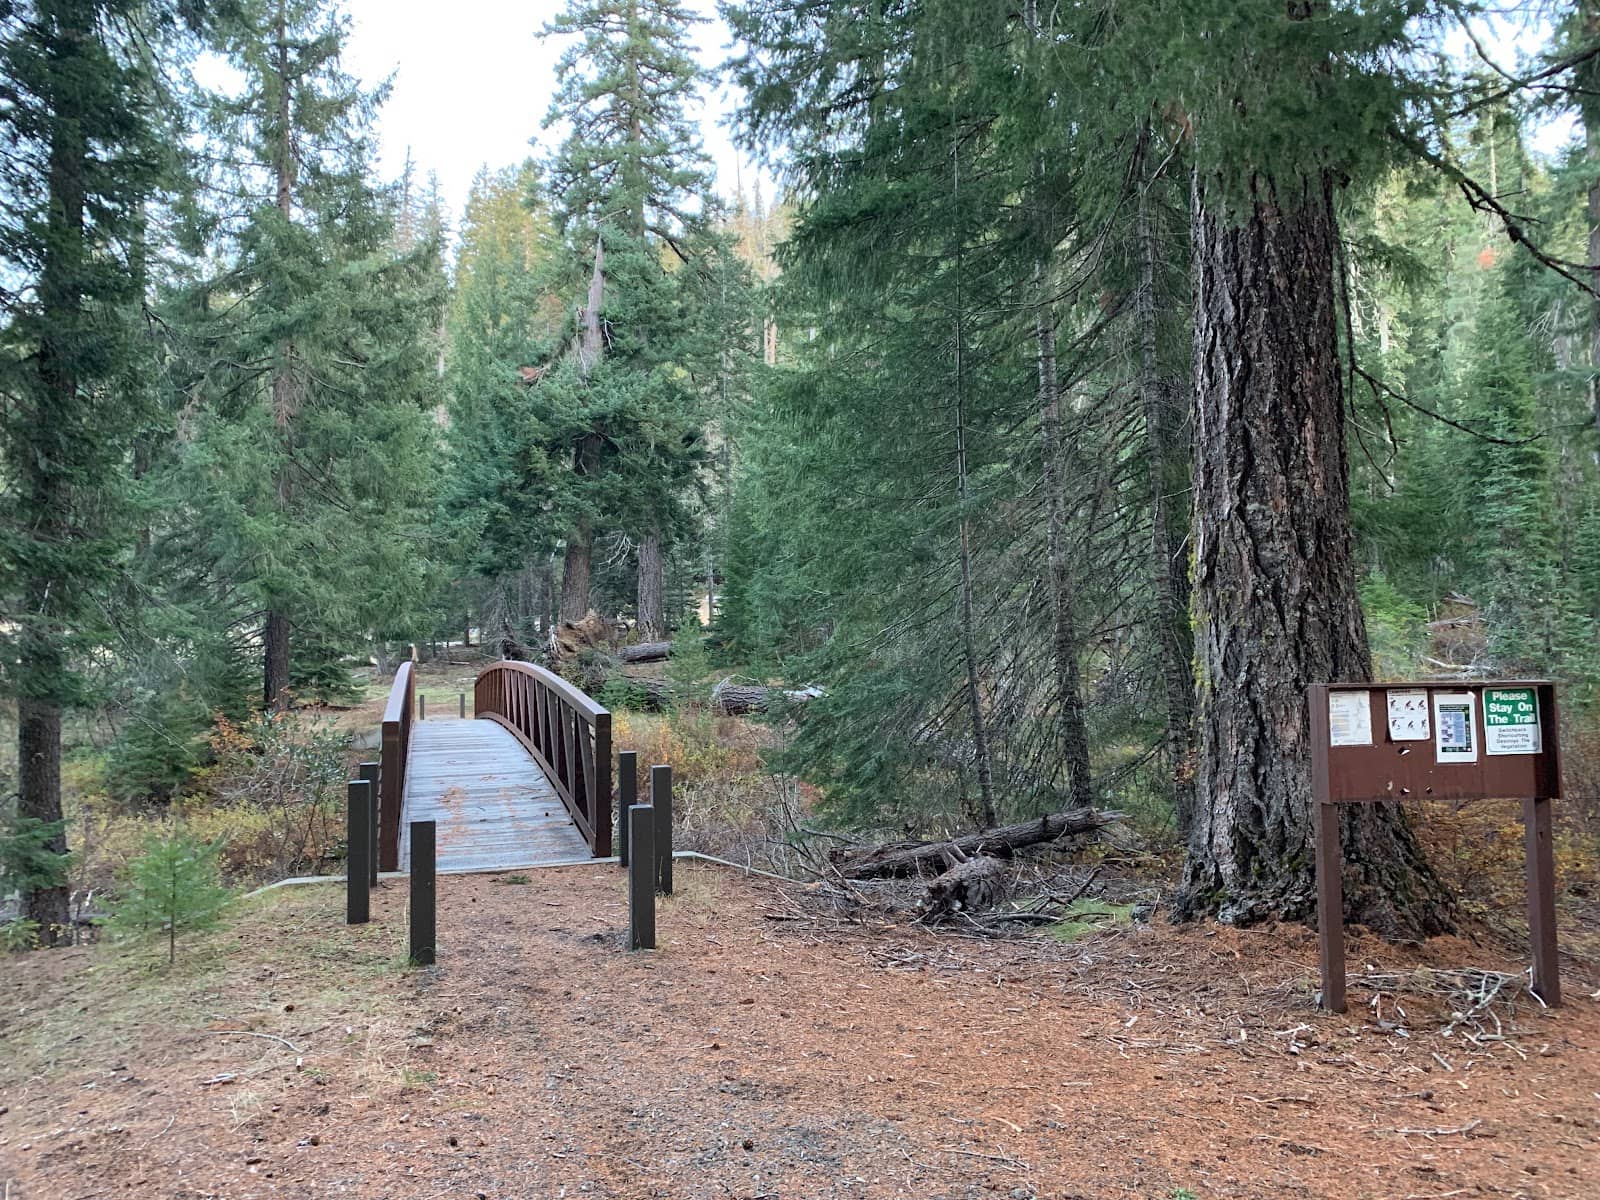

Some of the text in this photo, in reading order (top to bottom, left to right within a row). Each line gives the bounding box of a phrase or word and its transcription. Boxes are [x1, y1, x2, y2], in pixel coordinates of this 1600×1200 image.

[1492, 691, 1528, 701] Please
[1489, 702, 1533, 714] Stay On
[1488, 713, 1536, 724] The Trail
